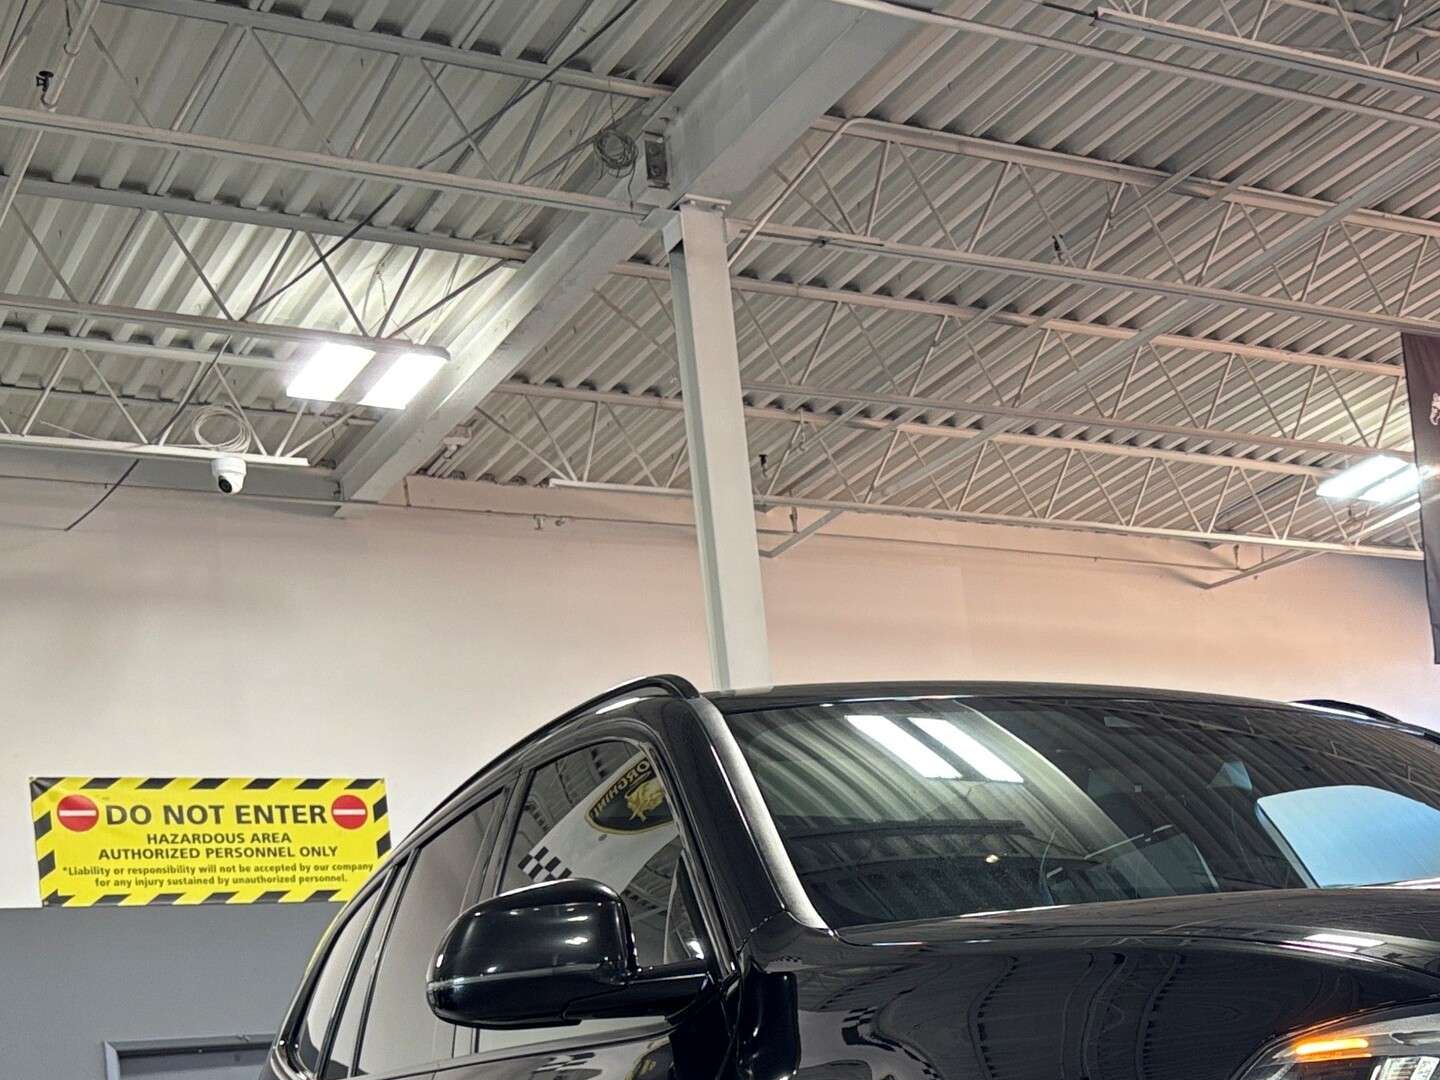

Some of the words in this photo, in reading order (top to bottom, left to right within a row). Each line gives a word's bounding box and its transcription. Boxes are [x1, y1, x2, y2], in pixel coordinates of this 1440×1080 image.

[106, 804, 152, 826] DO
[163, 804, 225, 825] NOT
[235, 804, 328, 825] ENTER
[147, 832, 245, 845] HAZARDOUS
[250, 832, 292, 844] AREA
[98, 848, 200, 860] AUTHORIZED
[206, 847, 296, 859] PERSONNEL
[300, 846, 338, 857] ONLY
[127, 865, 196, 876] responsibility
[198, 864, 217, 874] will
[219, 865, 237, 873] not
[238, 864, 251, 873] be
[253, 863, 297, 874] accepted
[299, 863, 311, 874] by
[331, 863, 374, 873] company
[95, 878, 112, 887] for
[113, 880, 132, 888] any
[135, 877, 164, 888] injury
[167, 877, 215, 886] sustained
[217, 876, 230, 886] by
[232, 875, 296, 885] unauthorized
[299, 873, 348, 885] personnel.
